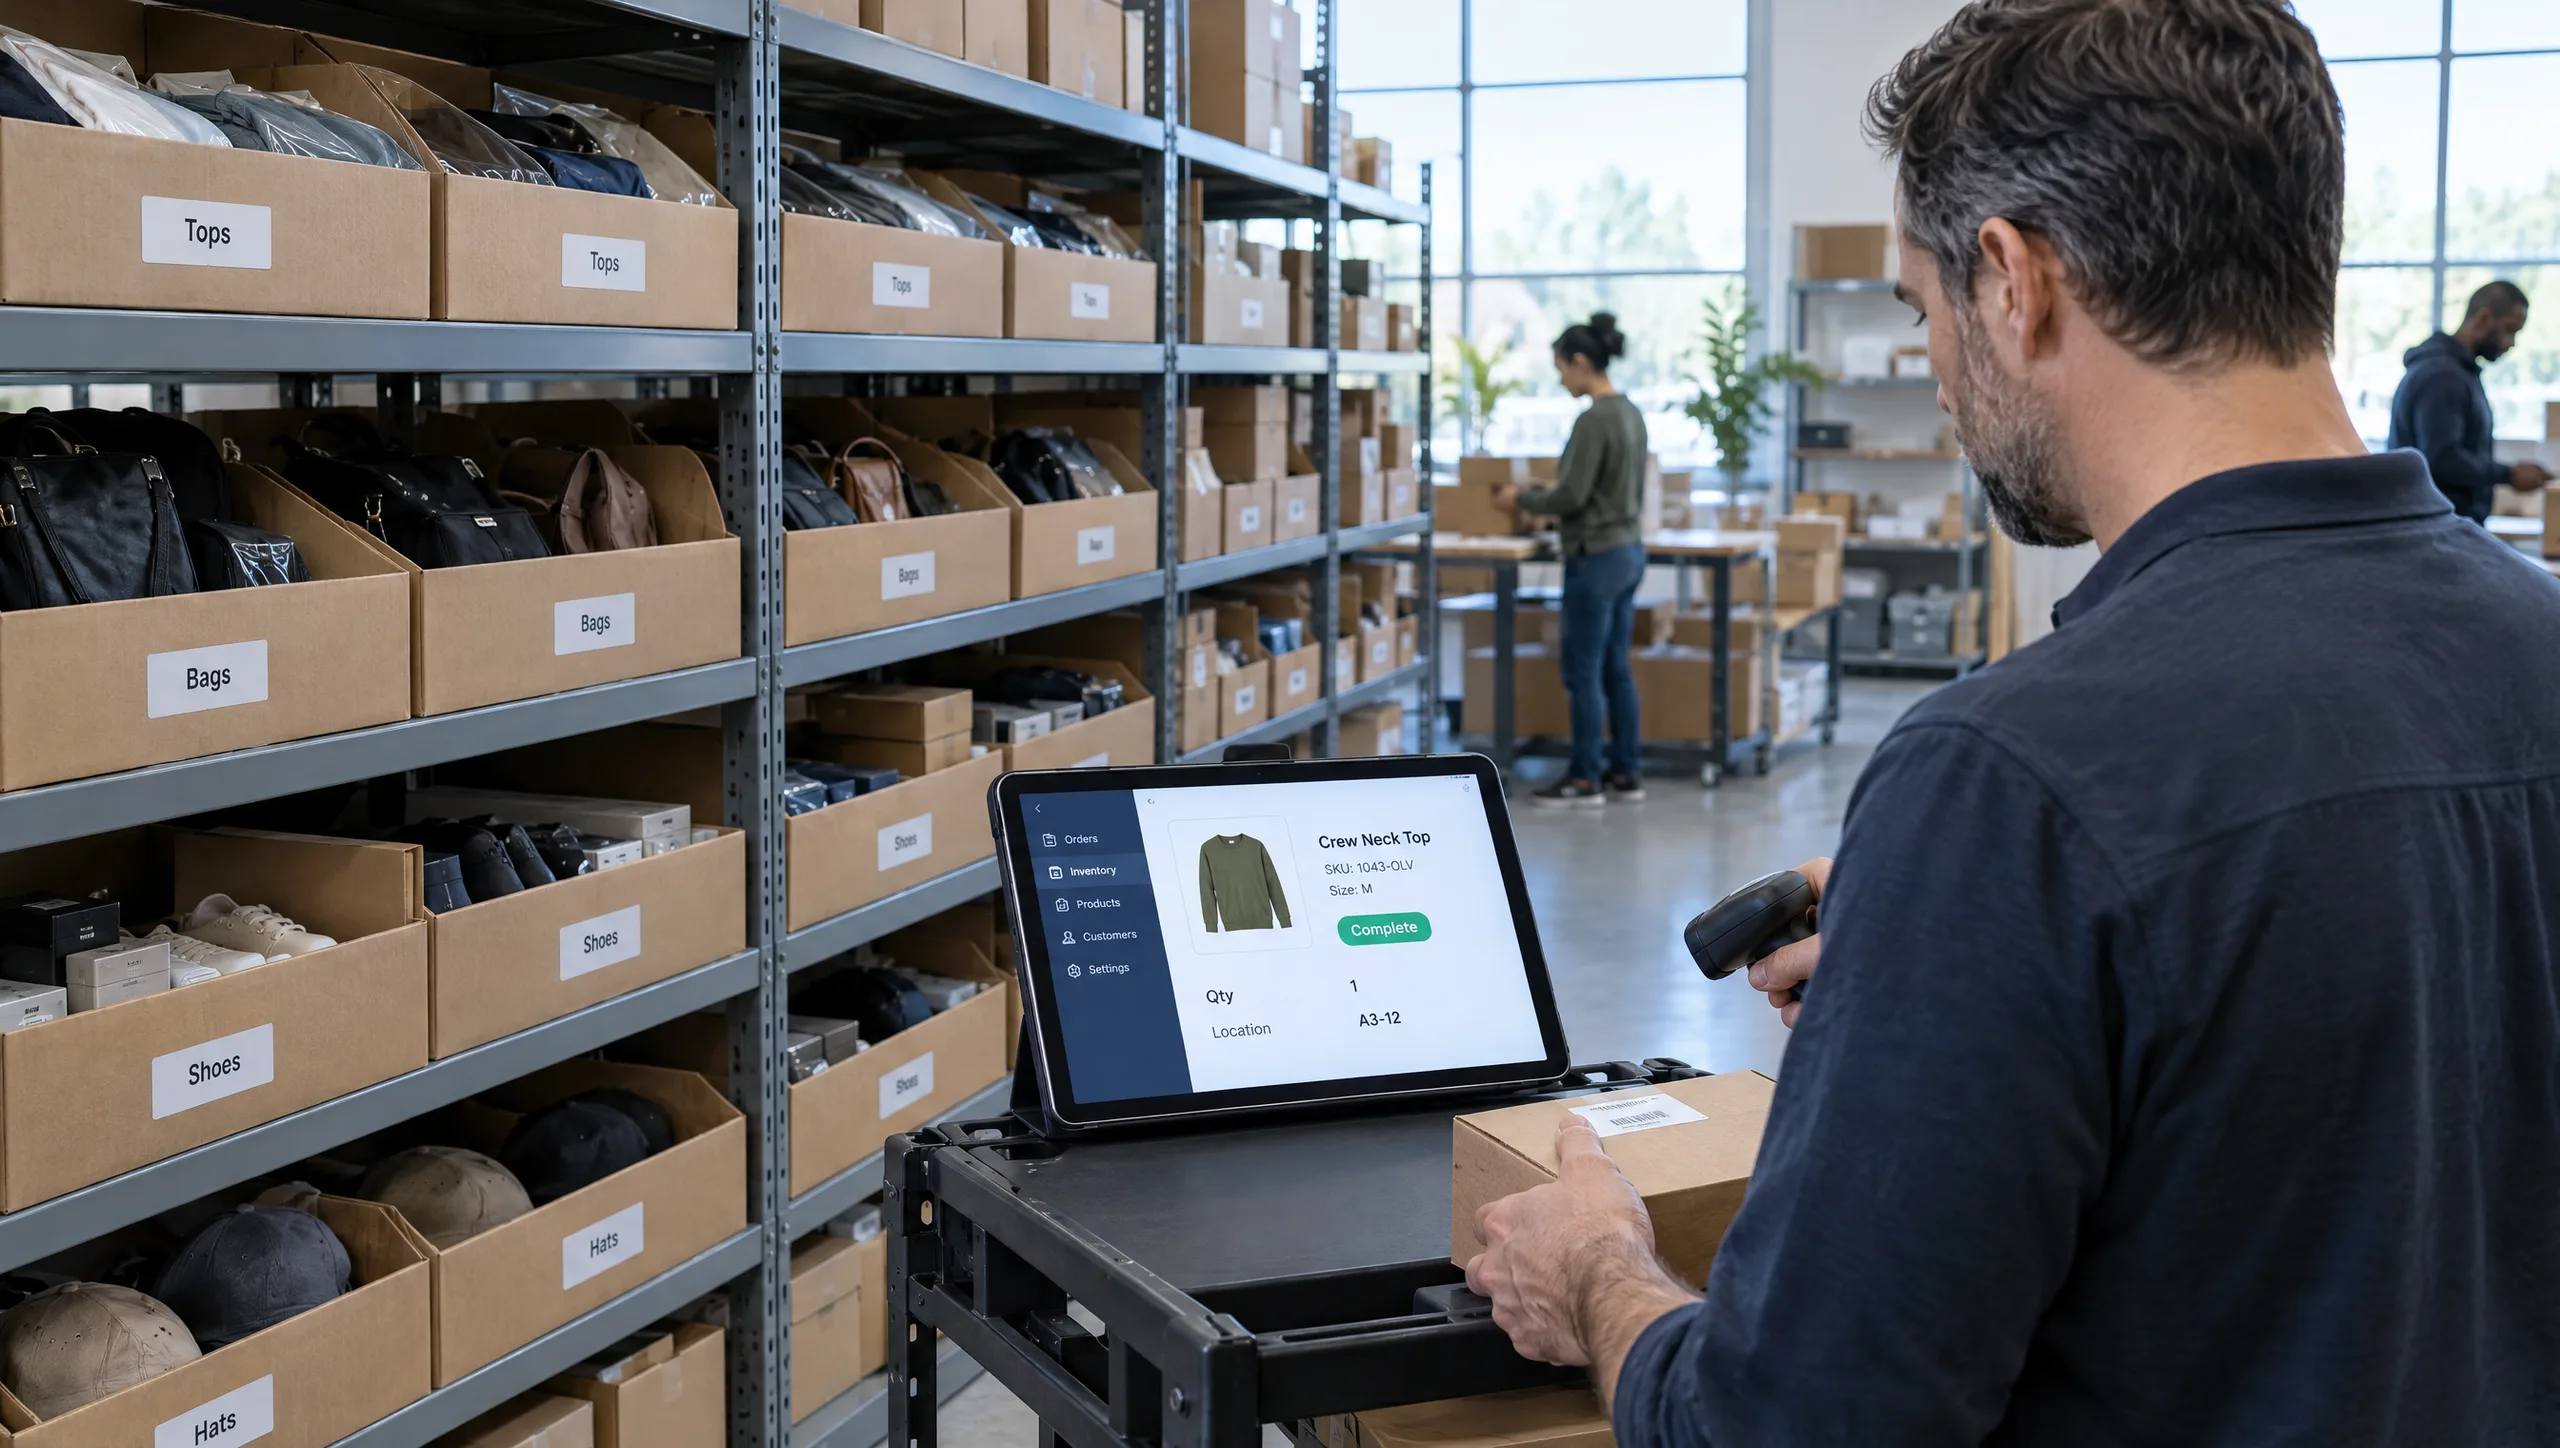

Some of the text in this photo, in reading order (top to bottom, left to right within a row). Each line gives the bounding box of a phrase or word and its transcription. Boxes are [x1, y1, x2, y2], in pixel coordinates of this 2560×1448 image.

[185, 217, 231, 250] Tops
[590, 251, 620, 275] Tops
[891, 276, 912, 295] Tops
[581, 614, 611, 636] Bags
[186, 667, 231, 692] Bags
[894, 833, 918, 852] Shoes
[1064, 834, 1099, 845] Orders
[1318, 831, 1431, 849] Crew Neck Top
[1069, 865, 1117, 880] Inventory
[1324, 859, 1414, 876] SKU: 1043-OLV
[1329, 883, 1374, 897] Size: M
[1076, 898, 1121, 909] Products
[1082, 930, 1138, 942] Customers
[1350, 921, 1419, 938] Complete
[583, 931, 619, 954] Shoes
[1088, 962, 1130, 978] Settings
[1349, 979, 1358, 993] 1
[1206, 988, 1234, 1006] Qty
[1358, 1010, 1402, 1028] A3-12
[1211, 1021, 1272, 1040] Location
[188, 1055, 241, 1085] Shoes
[590, 1232, 619, 1258] Hats
[194, 1412, 237, 1447] Hats
